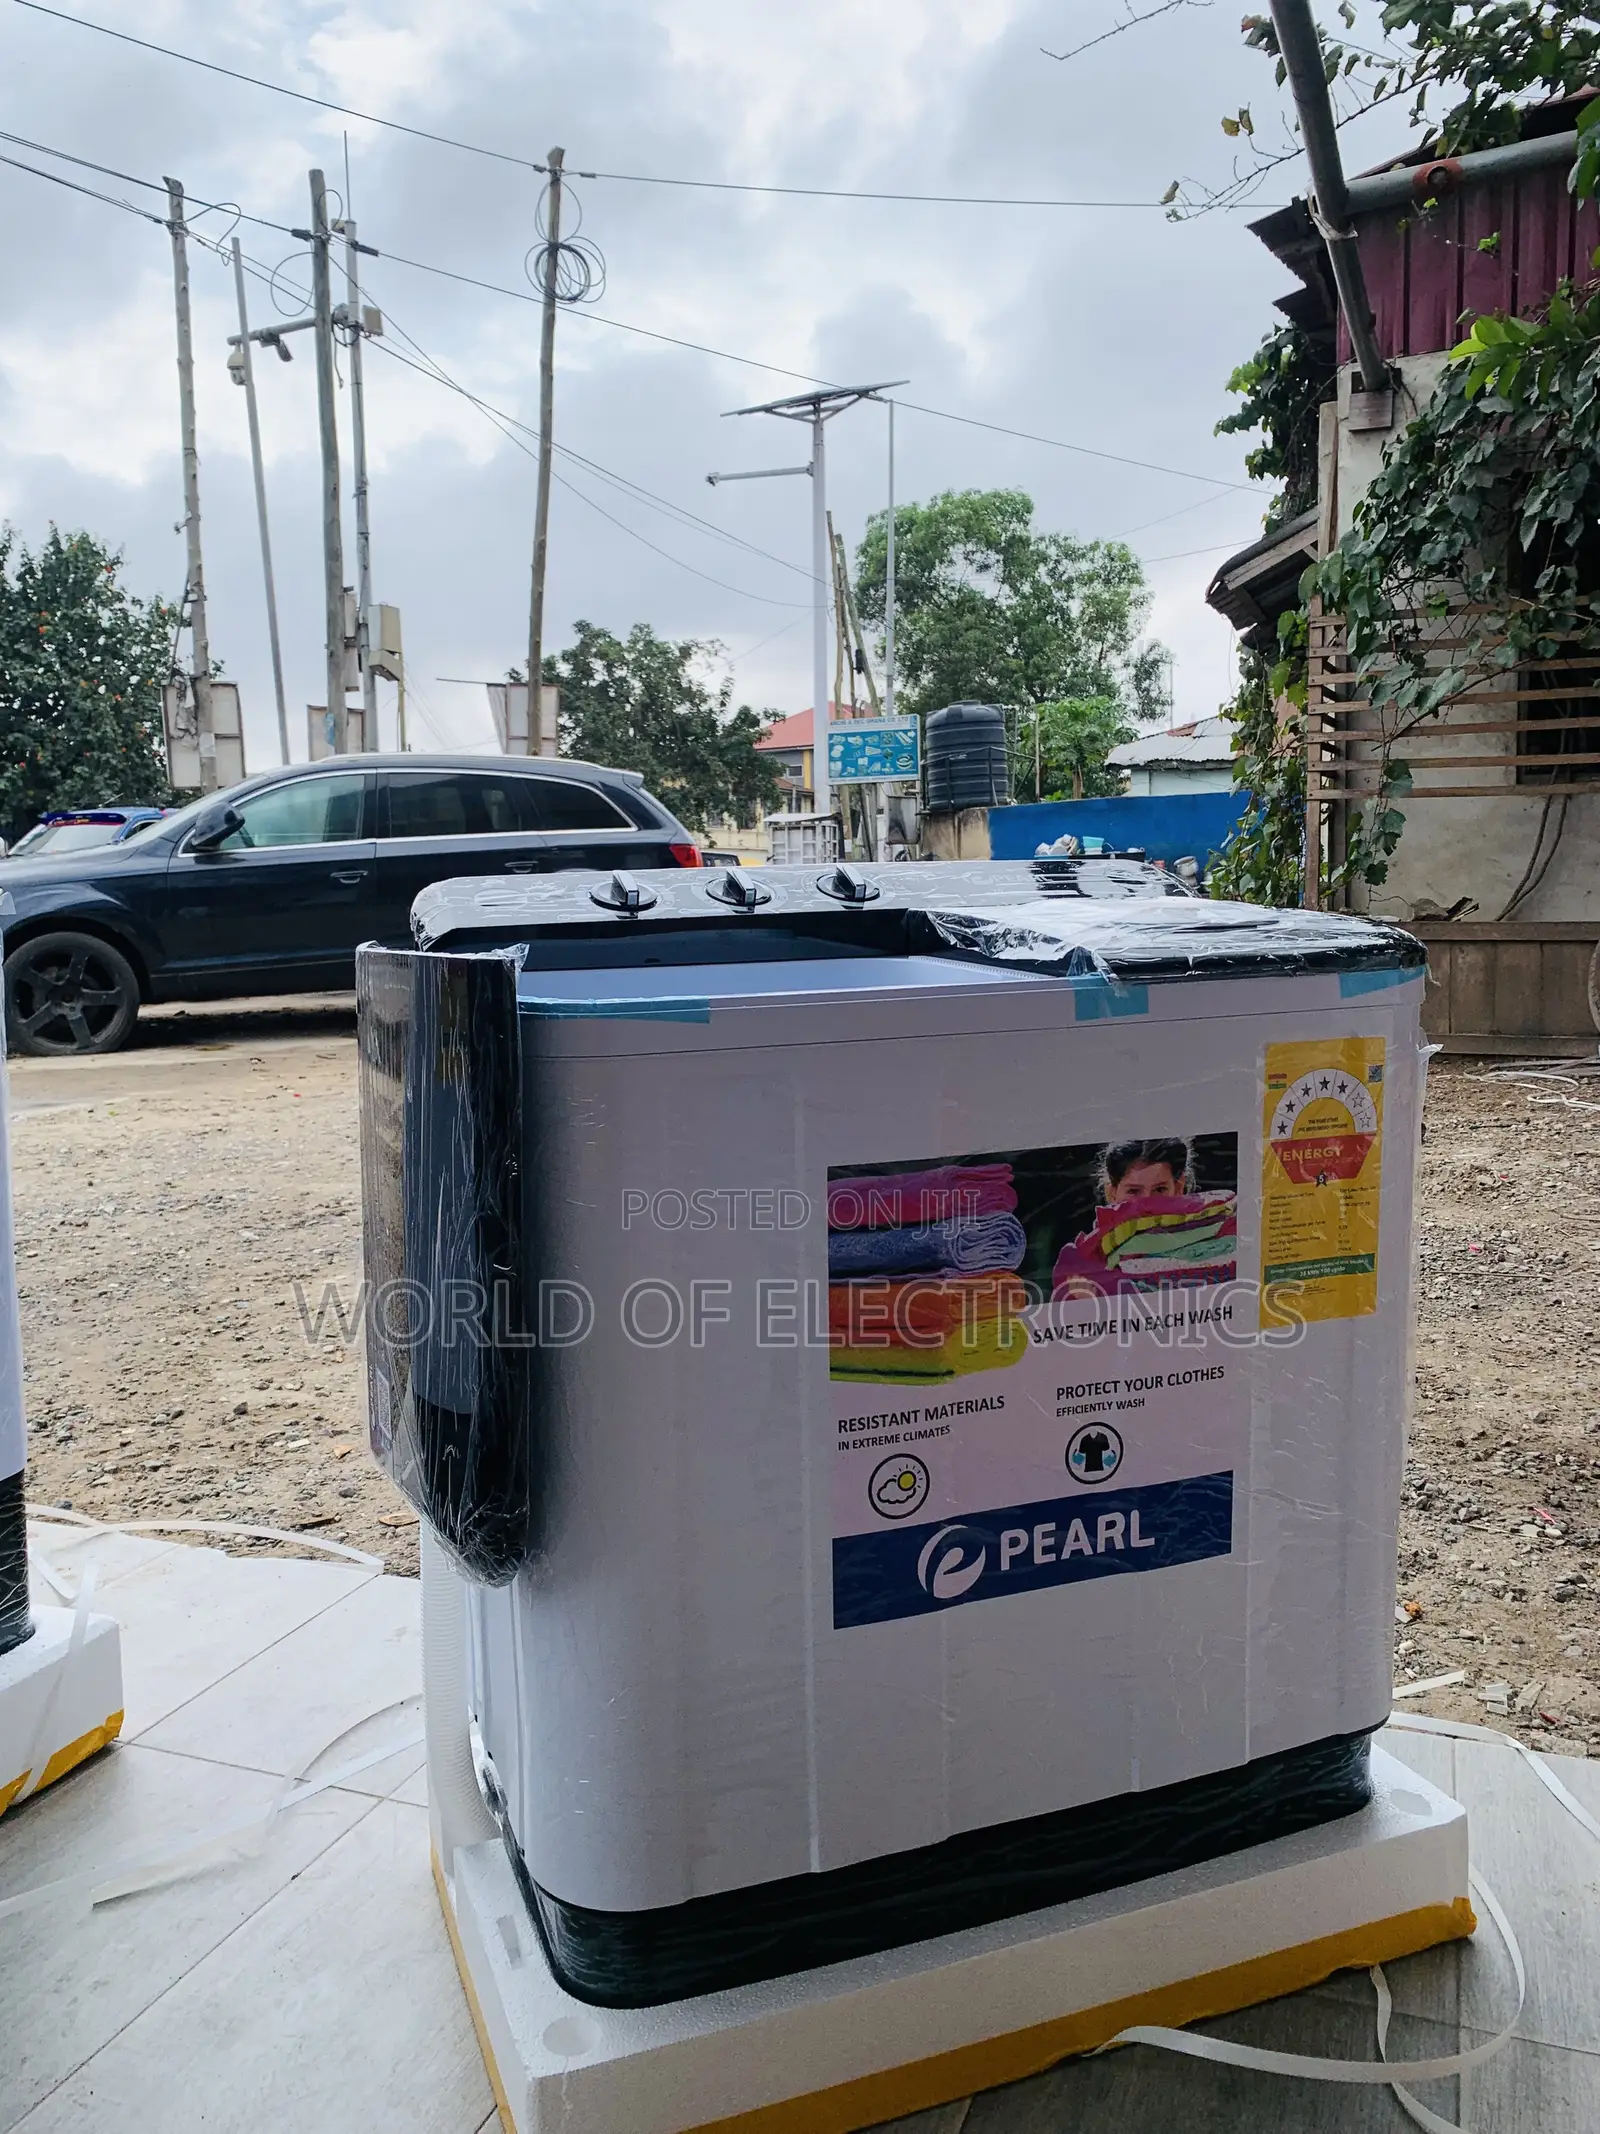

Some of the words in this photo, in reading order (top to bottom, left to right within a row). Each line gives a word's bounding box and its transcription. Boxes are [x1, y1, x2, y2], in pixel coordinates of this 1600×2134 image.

[1283, 1145, 1341, 1161] ENERGY
[1319, 1174, 1324, 1183] 5
[1033, 1326, 1074, 1344] SAVE
[1078, 1320, 1118, 1340] TIME
[1122, 1316, 1140, 1335] IN
[1144, 1310, 1184, 1332] EACH
[1188, 1305, 1233, 1326] WASH
[1056, 1380, 1120, 1402] PROTECT
[1124, 1375, 1164, 1393] YOUR
[1167, 1366, 1225, 1388] CLOTHES
[838, 1410, 921, 1434] RESISTANT
[924, 1395, 1005, 1422] MATERIALS
[1056, 1401, 1113, 1418] EFFICIENTLY
[1116, 1397, 1146, 1411] WASH
[838, 1440, 850, 1451] IN
[852, 1433, 901, 1450] EXTREME
[903, 1425, 951, 1443] CLIMATES
[1000, 1509, 1156, 1571] PEARL
